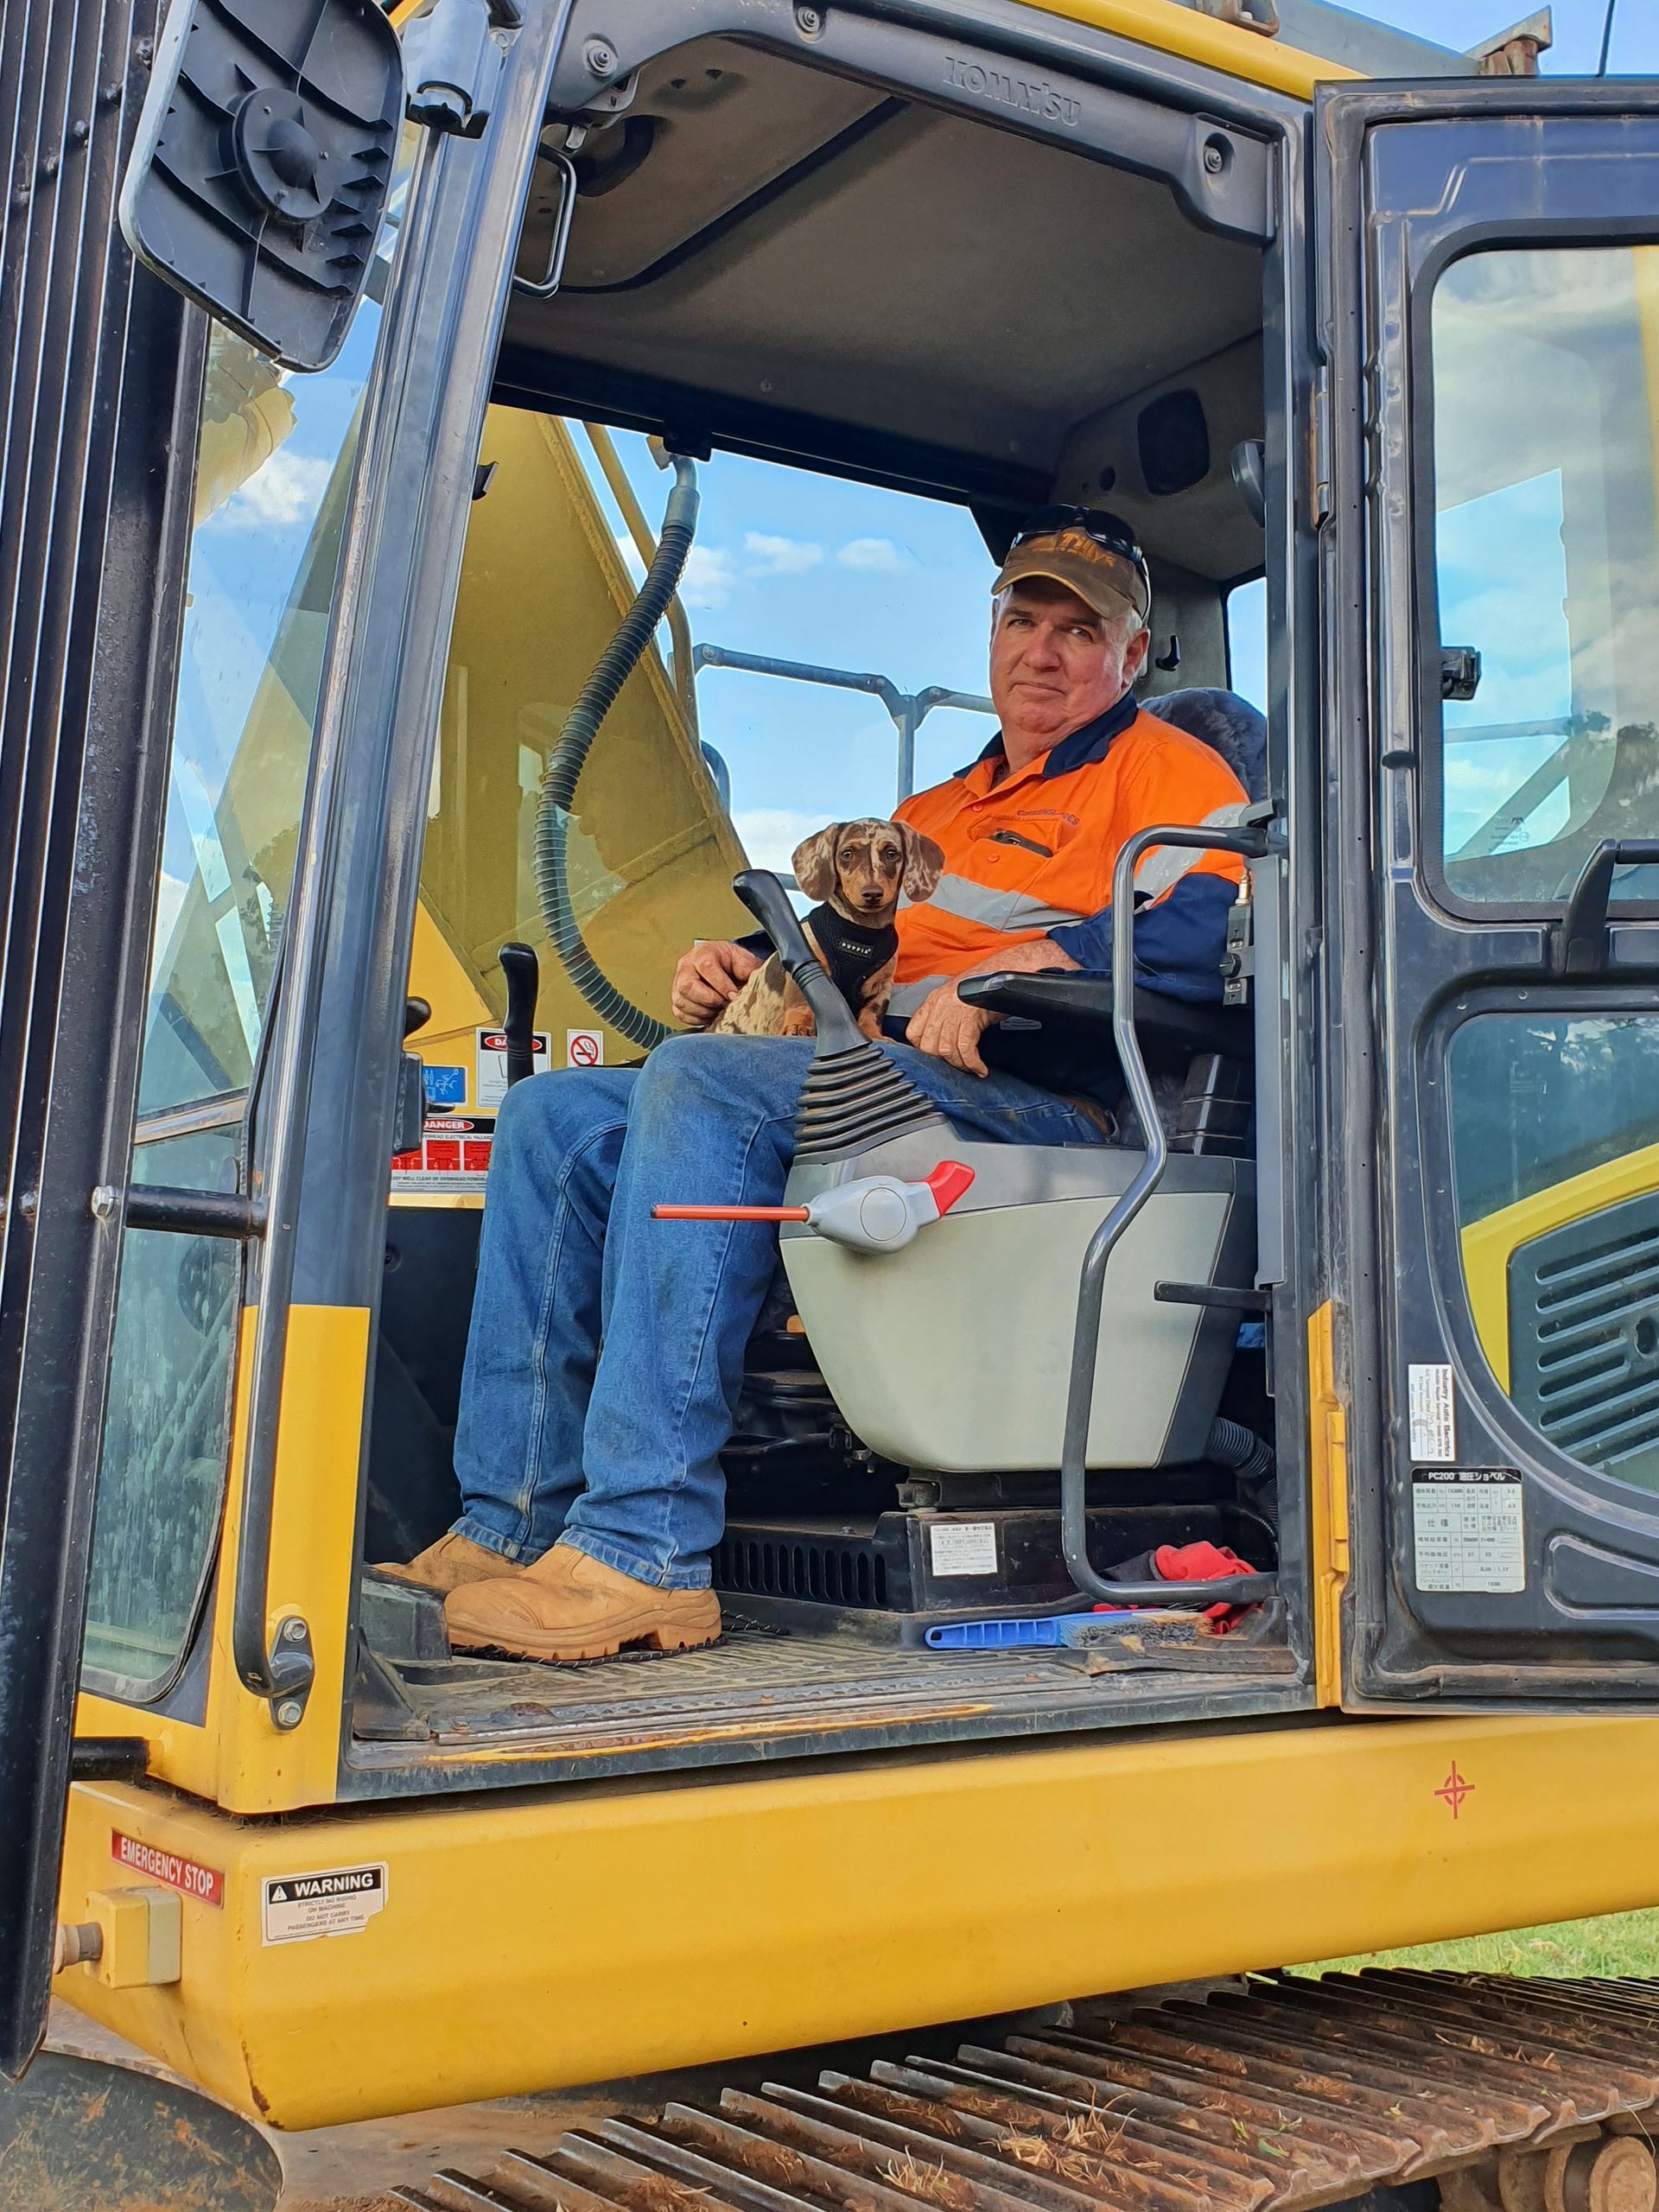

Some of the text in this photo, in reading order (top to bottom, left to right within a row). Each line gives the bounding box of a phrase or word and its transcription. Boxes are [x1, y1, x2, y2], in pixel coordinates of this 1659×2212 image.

[943, 55, 1081, 127] KOMATSU
[1428, 1471, 1455, 1480] PC200
[121, 1836, 214, 1897] EMERGENCY STOP
[295, 1872, 374, 1897] WARNING
[288, 1920, 327, 1930] PASSENGERS
